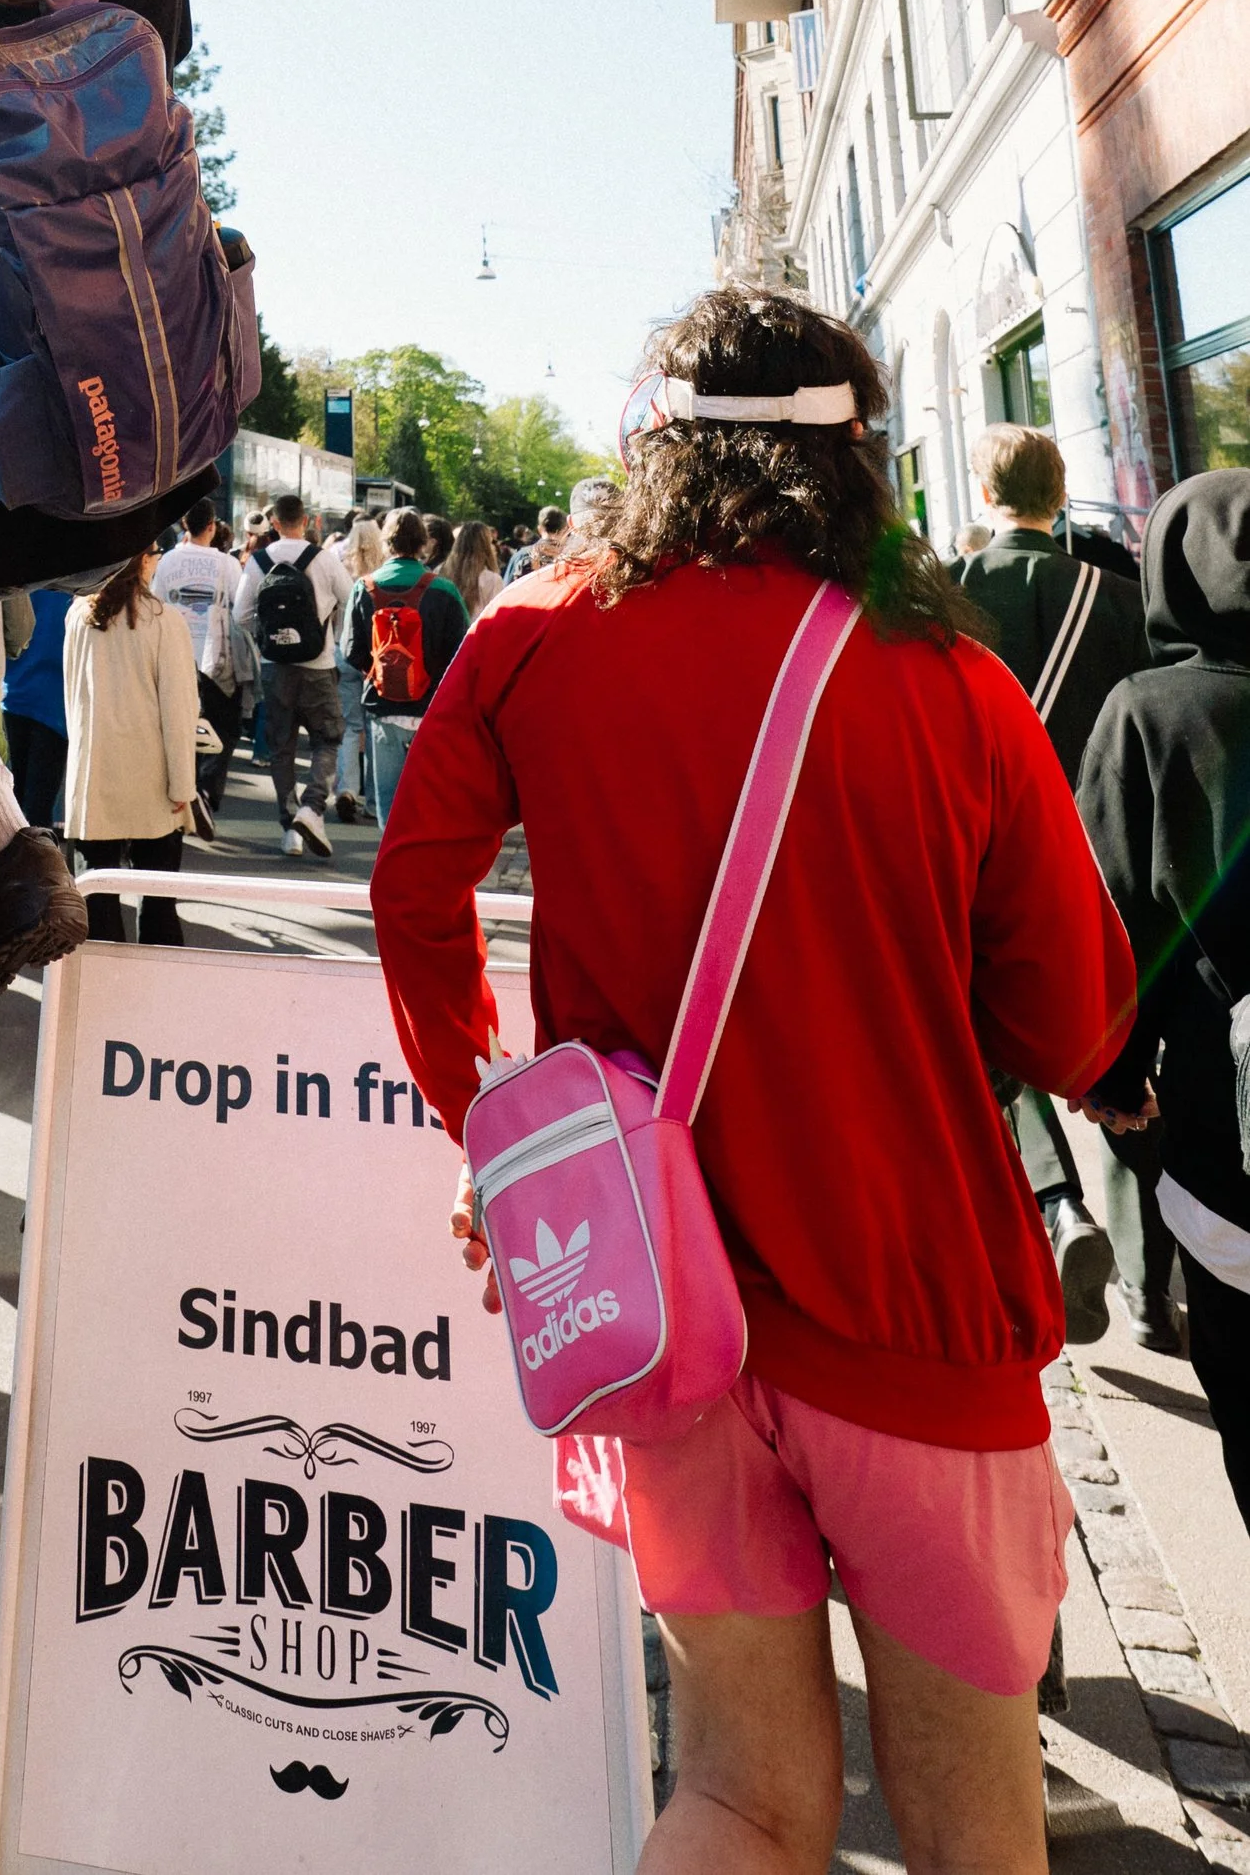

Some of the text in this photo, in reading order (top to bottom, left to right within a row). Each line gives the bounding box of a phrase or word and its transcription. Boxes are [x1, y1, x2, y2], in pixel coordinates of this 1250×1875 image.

[77, 375, 127, 503] patagonia
[165, 569, 185, 583] THE
[180, 558, 217, 569] CHASE
[102, 1039, 447, 1131] Drop in fri
[178, 1287, 451, 1382] Sindbad
[521, 1289, 621, 1371] adidas
[187, 1389, 212, 1404] 1997
[410, 1420, 437, 1435] 1997
[75, 1455, 559, 1703] BARBER
[250, 1613, 370, 1685] SHOP
[225, 1700, 396, 1742] CLASSIC CUTS AND CLOSE SHAVES
